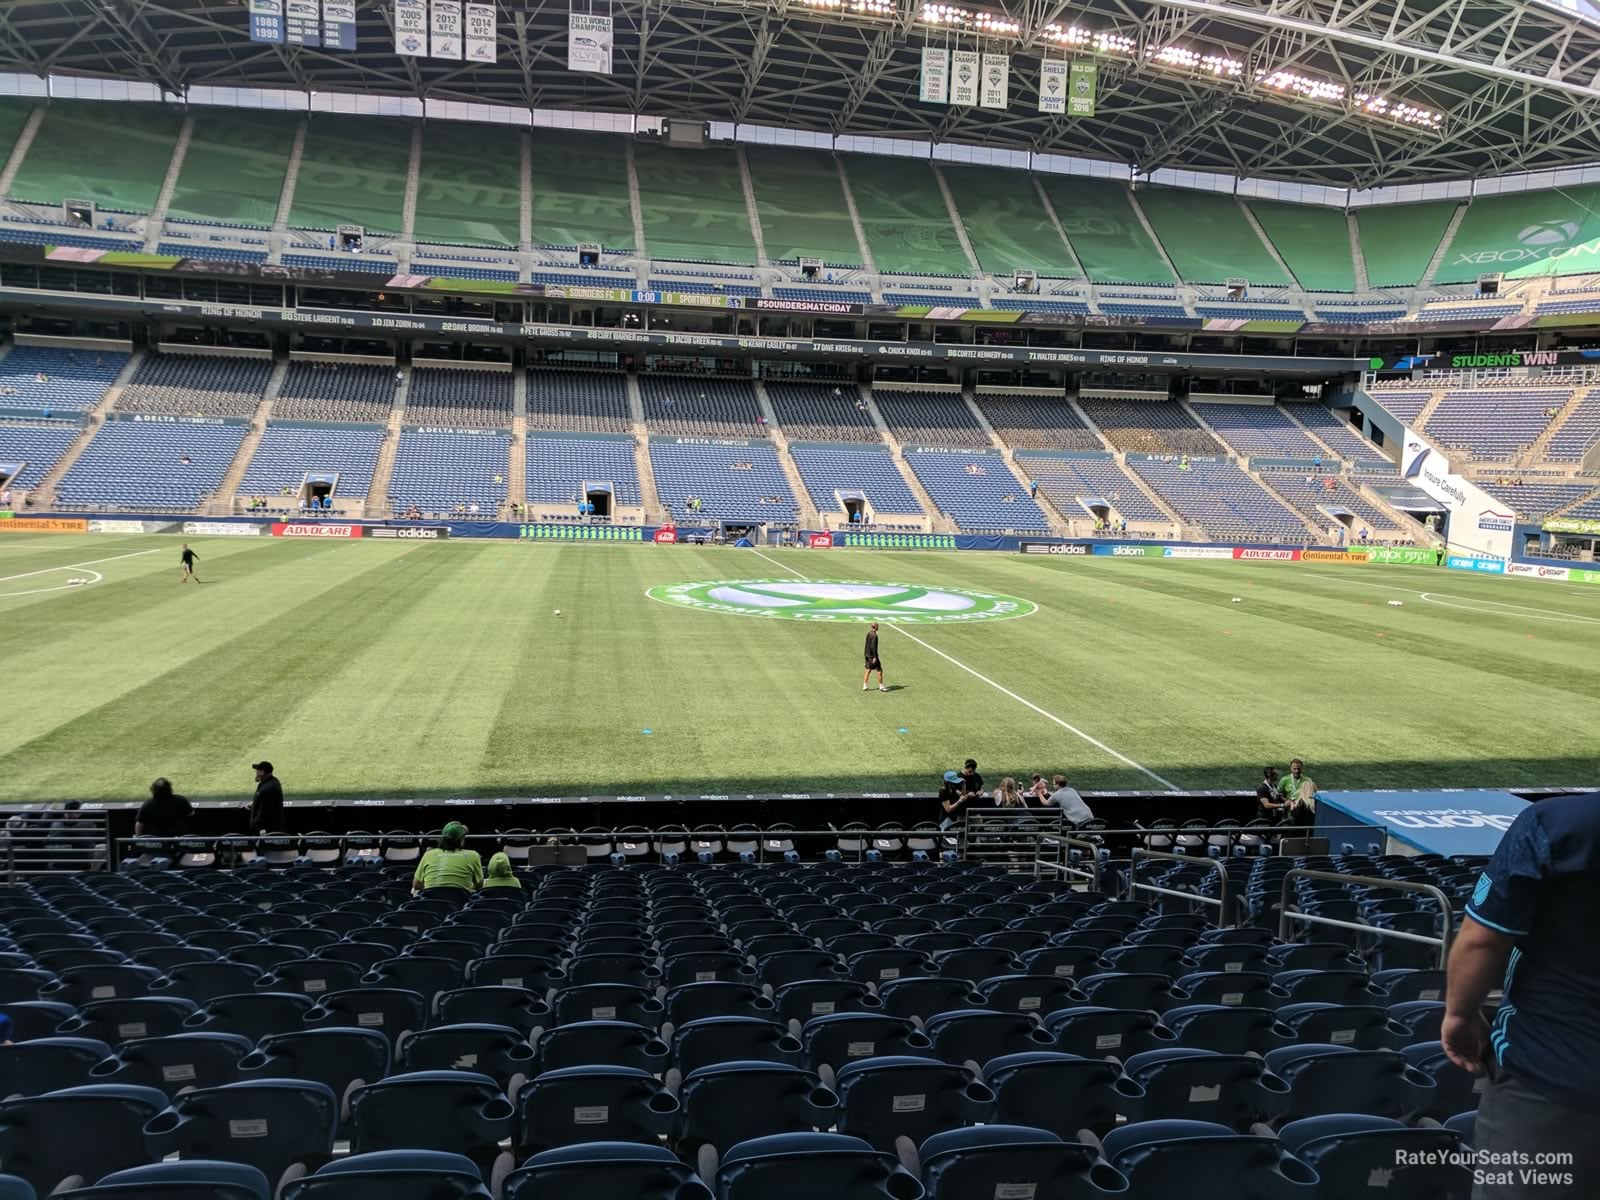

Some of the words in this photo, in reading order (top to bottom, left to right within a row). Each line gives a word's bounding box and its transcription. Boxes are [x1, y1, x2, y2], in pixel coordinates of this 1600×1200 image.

[400, 10, 422, 20] 2005
[436, 14, 456, 24] 2013
[470, 18, 492, 27] 2014
[570, 15, 588, 24] 2013
[588, 17, 610, 26] WORLD
[438, 24, 454, 32] NFC
[570, 22, 610, 32] CHAMPIONS
[256, 28, 278, 38] 1999
[1043, 66, 1065, 74] SHIELD
[1452, 247, 1546, 266] XBOX
[570, 288, 605, 299] SOUNDERS
[606, 289, 614, 300] FC
[620, 290, 626, 300] 0
[637, 291, 655, 302] 0:00
[666, 293, 673, 303] 0
[679, 294, 712, 305] SPORTING
[712, 296, 721, 305] KC
[757, 300, 851, 313] #SOUNDERSMATCHDAY
[202, 305, 222, 315] RING
[224, 306, 234, 316] OF
[235, 308, 262, 319] HONOR
[293, 313, 312, 322] STEVE
[313, 314, 340, 324] LARGENT
[468, 324, 490, 333] BROWN
[525, 326, 539, 336] PETE
[692, 336, 710, 345] GREEN
[748, 340, 766, 348] KENNY
[766, 341, 785, 350] EASLEY
[821, 344, 834, 352] DAVE
[835, 345, 852, 353] KRIEG
[887, 347, 906, 355] CHUCK
[957, 350, 977, 358] CORTEZ
[977, 350, 1001, 359] KENNEDY
[1036, 353, 1057, 361] WALTER
[1057, 354, 1074, 362] JONES
[1100, 355, 1116, 363] RING
[1126, 356, 1148, 364] HONOR
[1452, 354, 1520, 367] STUDENTS
[1523, 353, 1558, 365] WIN!
[1424, 467, 1442, 487] Insure
[1440, 479, 1467, 506] Carefully
[0, 520, 49, 529] ntinental
[285, 526, 350, 536] ADVOCARE
[398, 528, 438, 539] adidas
[1050, 544, 1086, 555] adidas
[1113, 546, 1145, 556] slalom
[1242, 550, 1292, 560] ADVOCARE
[1303, 551, 1344, 560] Continental
